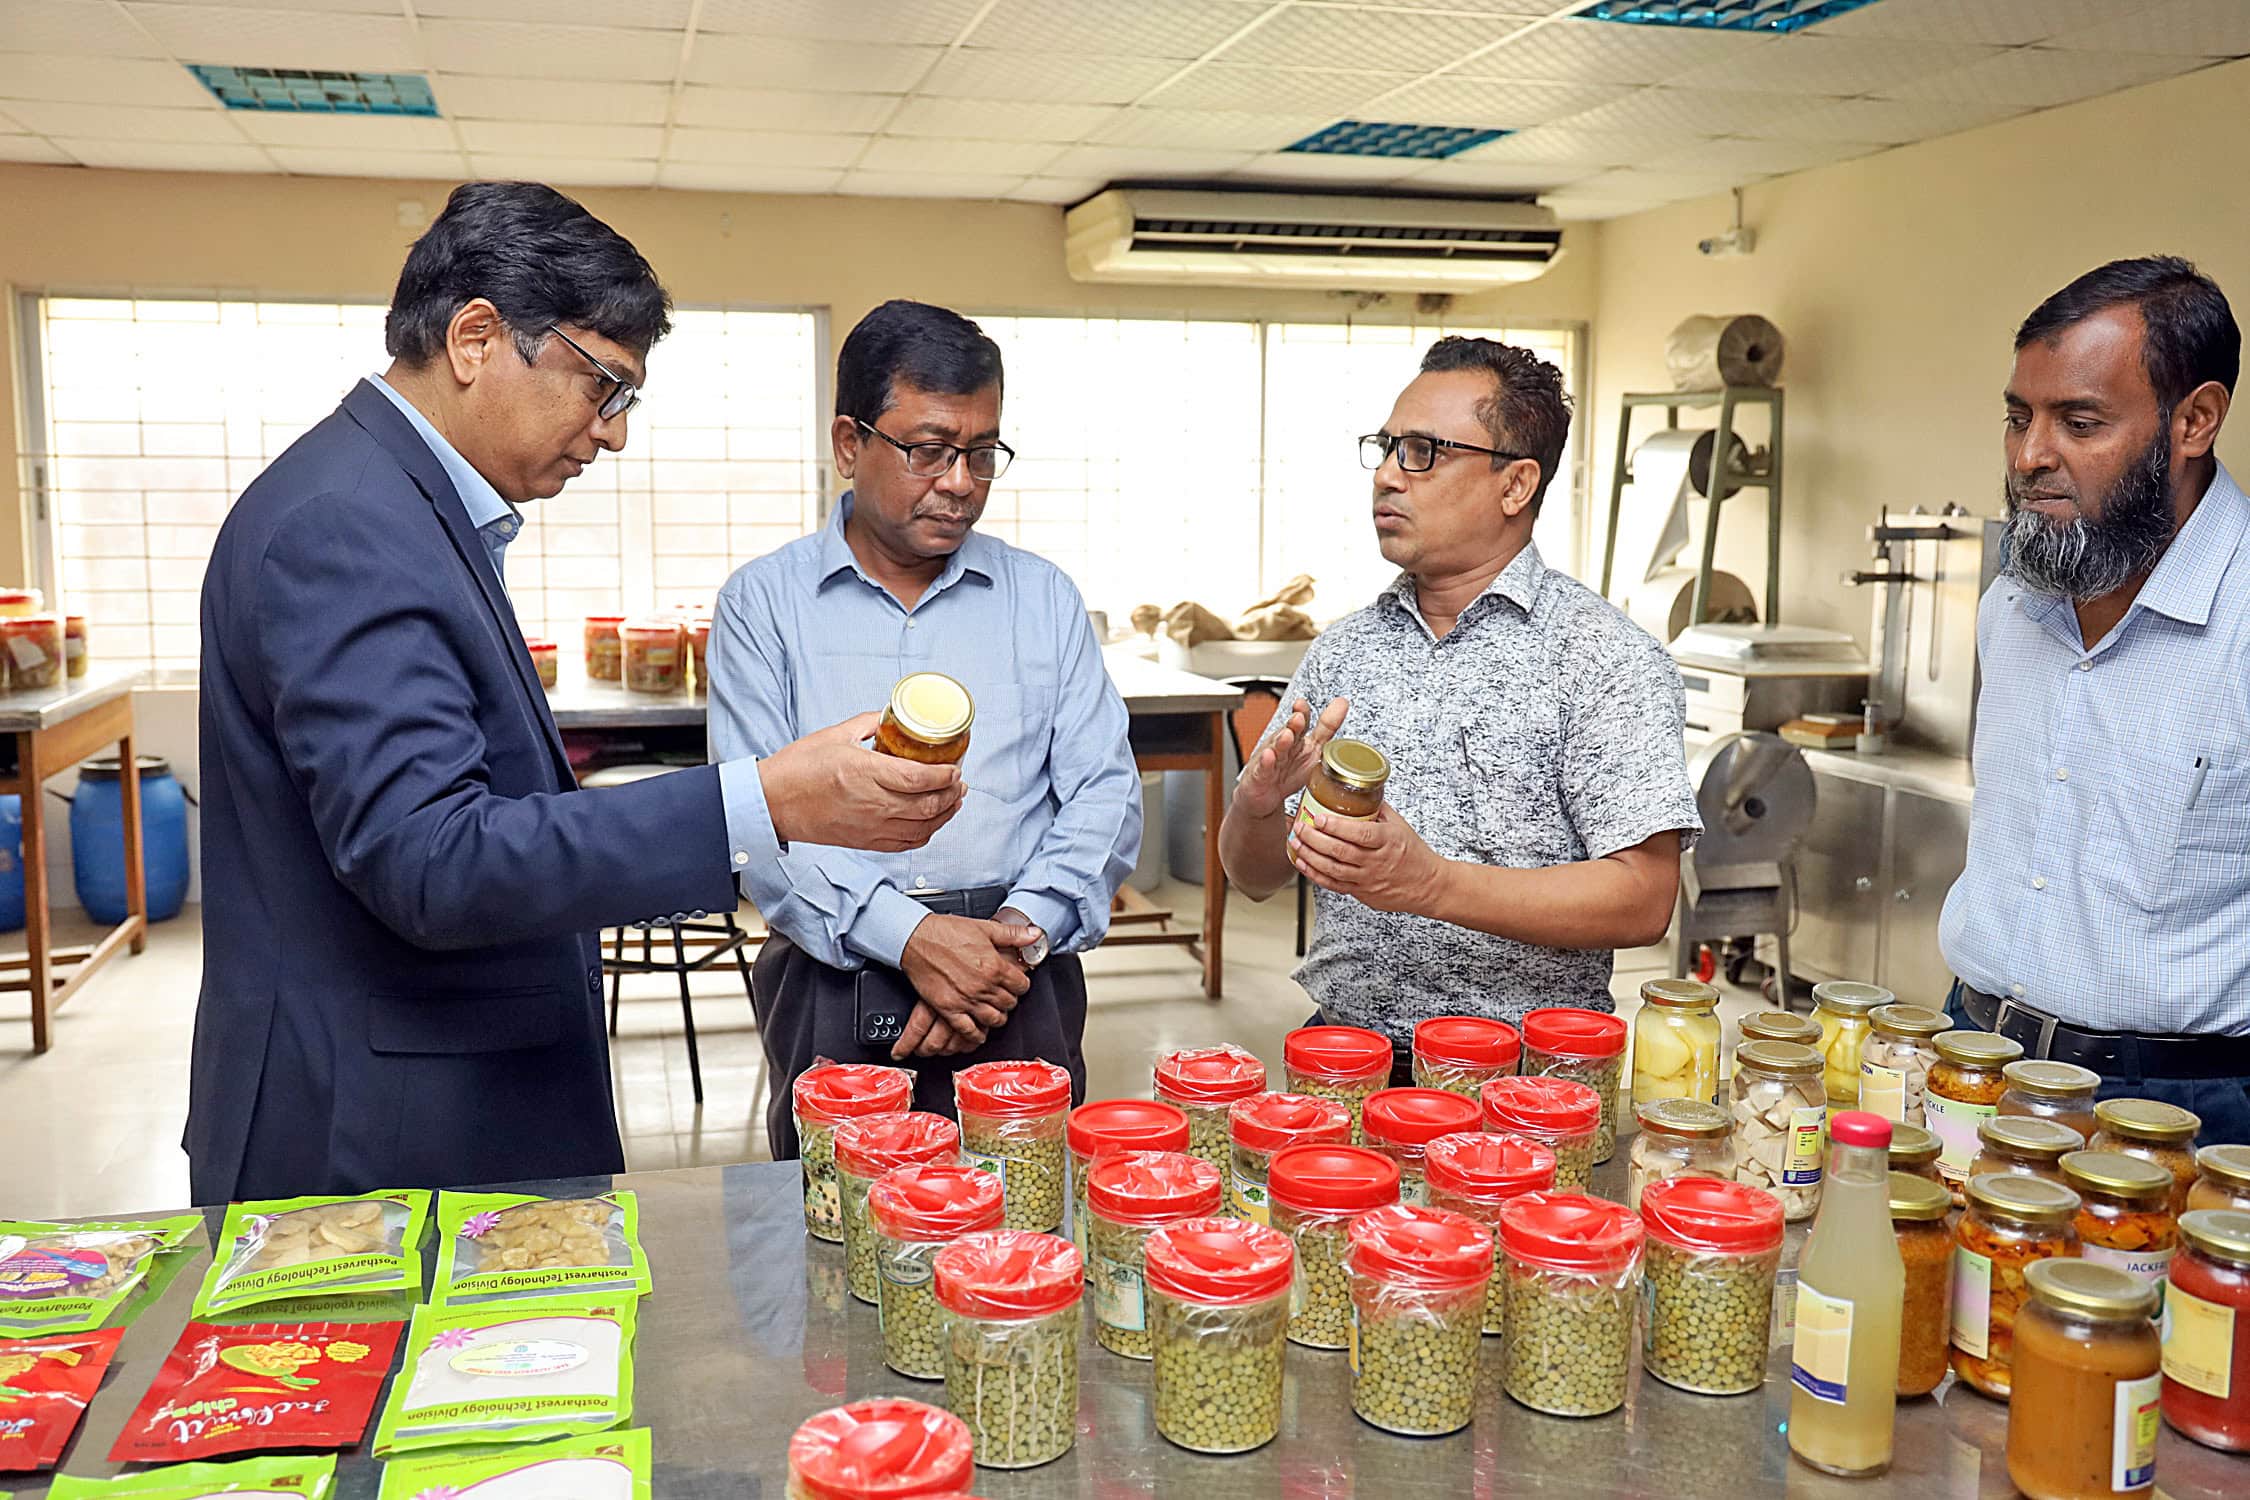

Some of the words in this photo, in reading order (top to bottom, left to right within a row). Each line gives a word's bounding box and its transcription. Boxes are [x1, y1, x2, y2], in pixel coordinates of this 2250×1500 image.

[332, 1258, 398, 1273] Postharvest
[266, 1264, 332, 1284] Technology
[500, 1273, 564, 1286] Technology
[564, 1270, 628, 1280] Postharvest
[223, 1277, 265, 1290] Divisio
[453, 1279, 498, 1291] Division
[26, 1302, 94, 1314] Postharvest
[461, 1400, 533, 1414] Technology
[535, 1398, 609, 1409] Postharvest
[406, 1406, 459, 1420] Division
